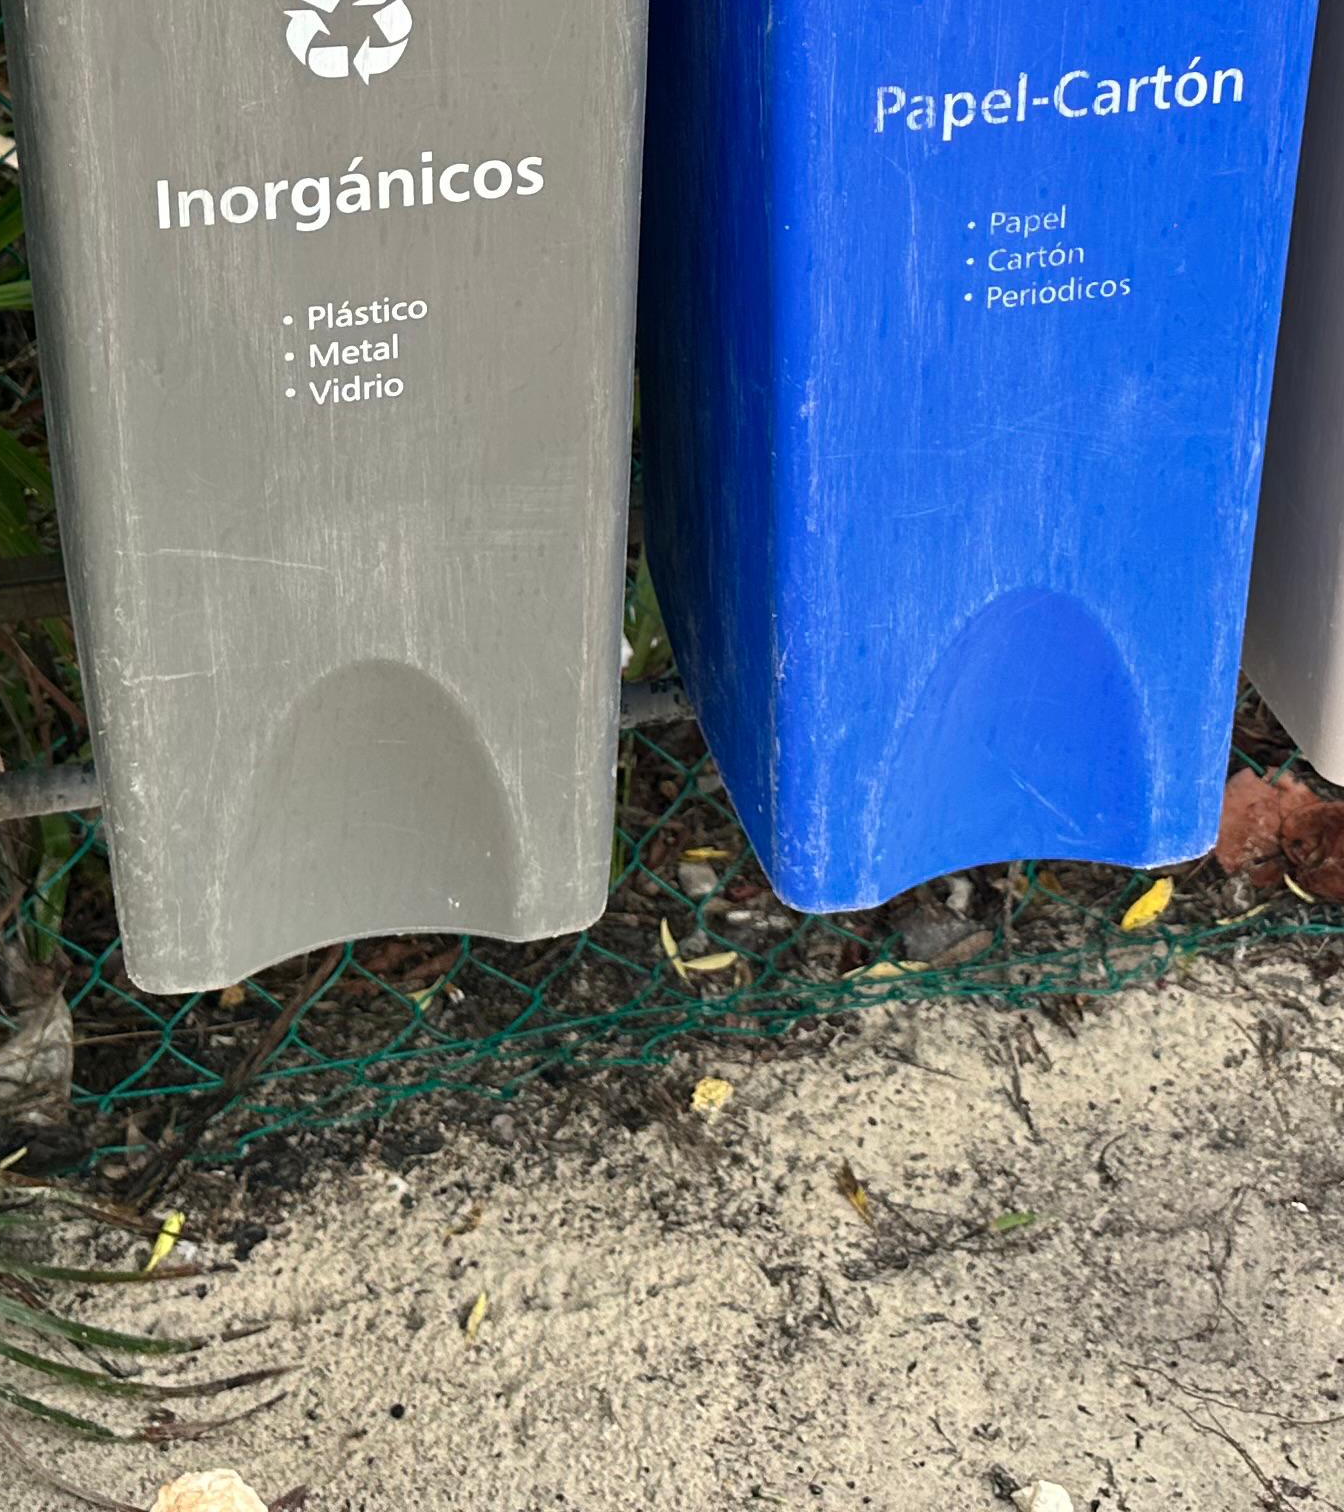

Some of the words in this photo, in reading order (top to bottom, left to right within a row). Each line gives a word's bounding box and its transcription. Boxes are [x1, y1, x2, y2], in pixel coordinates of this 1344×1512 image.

[873, 56, 1244, 141] Papel-Cartón
[156, 151, 544, 232] Inorgánicos
[990, 204, 1067, 238] Papel
[987, 241, 1085, 273] Cartón
[987, 276, 1131, 309] Periódicos
[307, 296, 429, 330] Plástico
[308, 333, 400, 368] Metal
[309, 373, 404, 405] Vidrio
